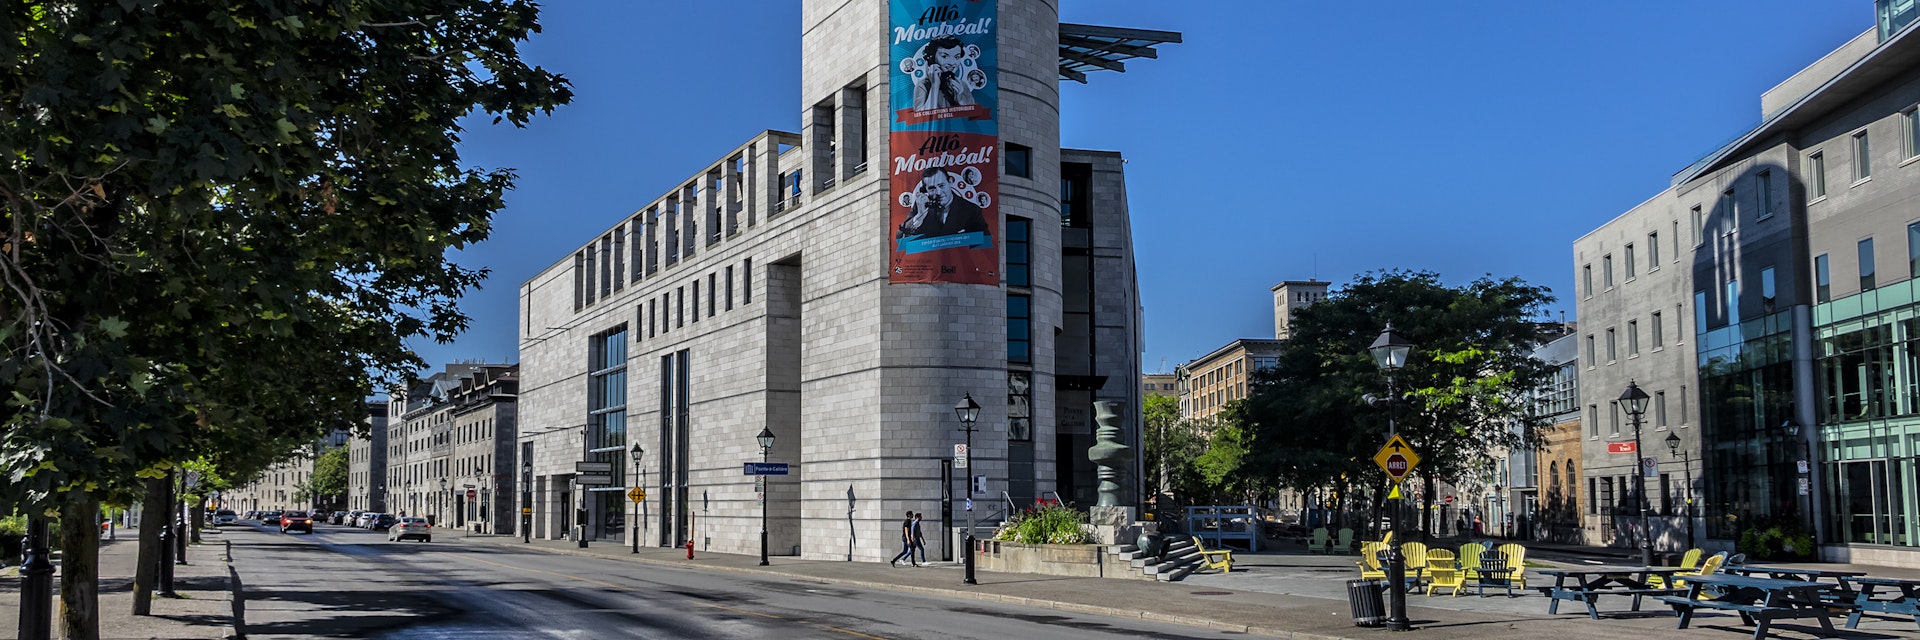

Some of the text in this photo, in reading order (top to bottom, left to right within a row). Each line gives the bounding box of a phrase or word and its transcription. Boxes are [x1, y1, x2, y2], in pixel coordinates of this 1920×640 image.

[919, 4, 960, 26] Allô
[894, 18, 992, 45] Montréal!
[922, 107, 949, 116] COLLECTIONS
[919, 134, 961, 156] Allô
[894, 146, 994, 176] Montréal!
[941, 266, 957, 274] Bell
